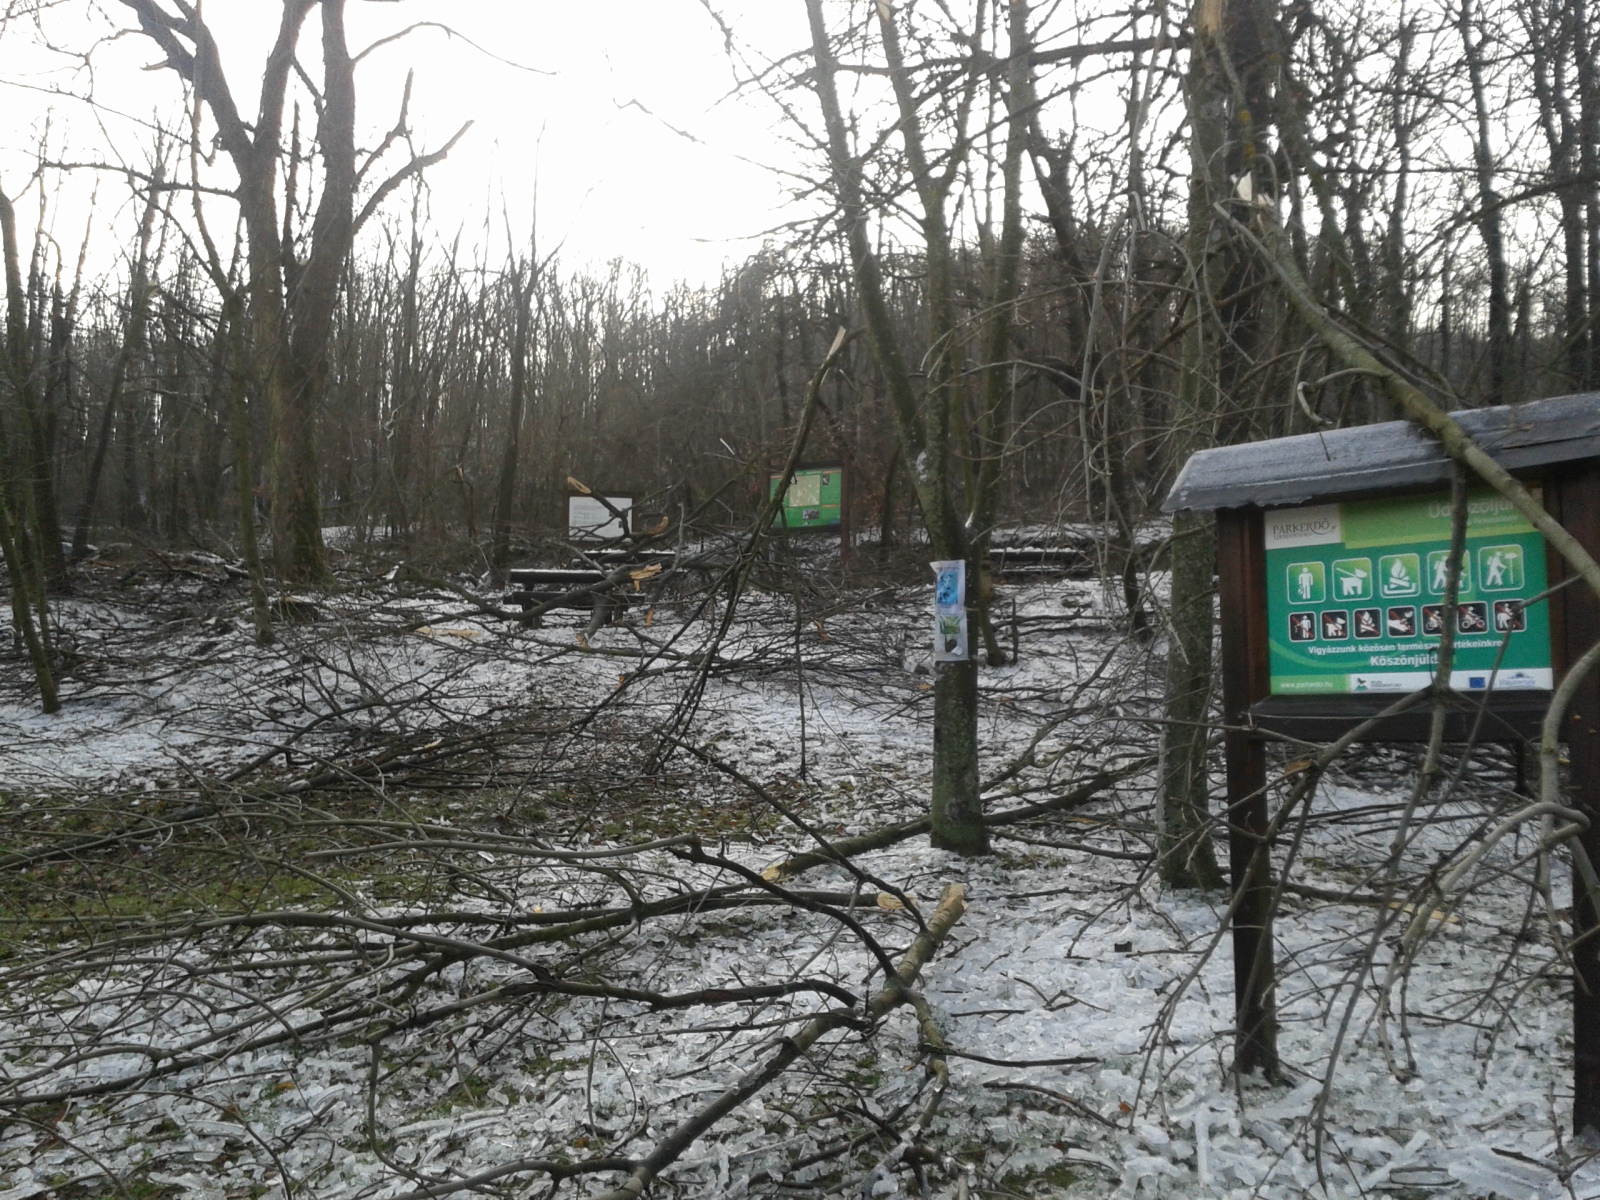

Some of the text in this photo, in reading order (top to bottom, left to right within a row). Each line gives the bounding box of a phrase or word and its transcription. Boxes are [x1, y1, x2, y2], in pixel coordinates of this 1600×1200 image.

[1273, 517, 1331, 535] PARKERDŐ
[1308, 645, 1357, 656] Vigyázzunk
[1358, 643, 1395, 653] közösen
